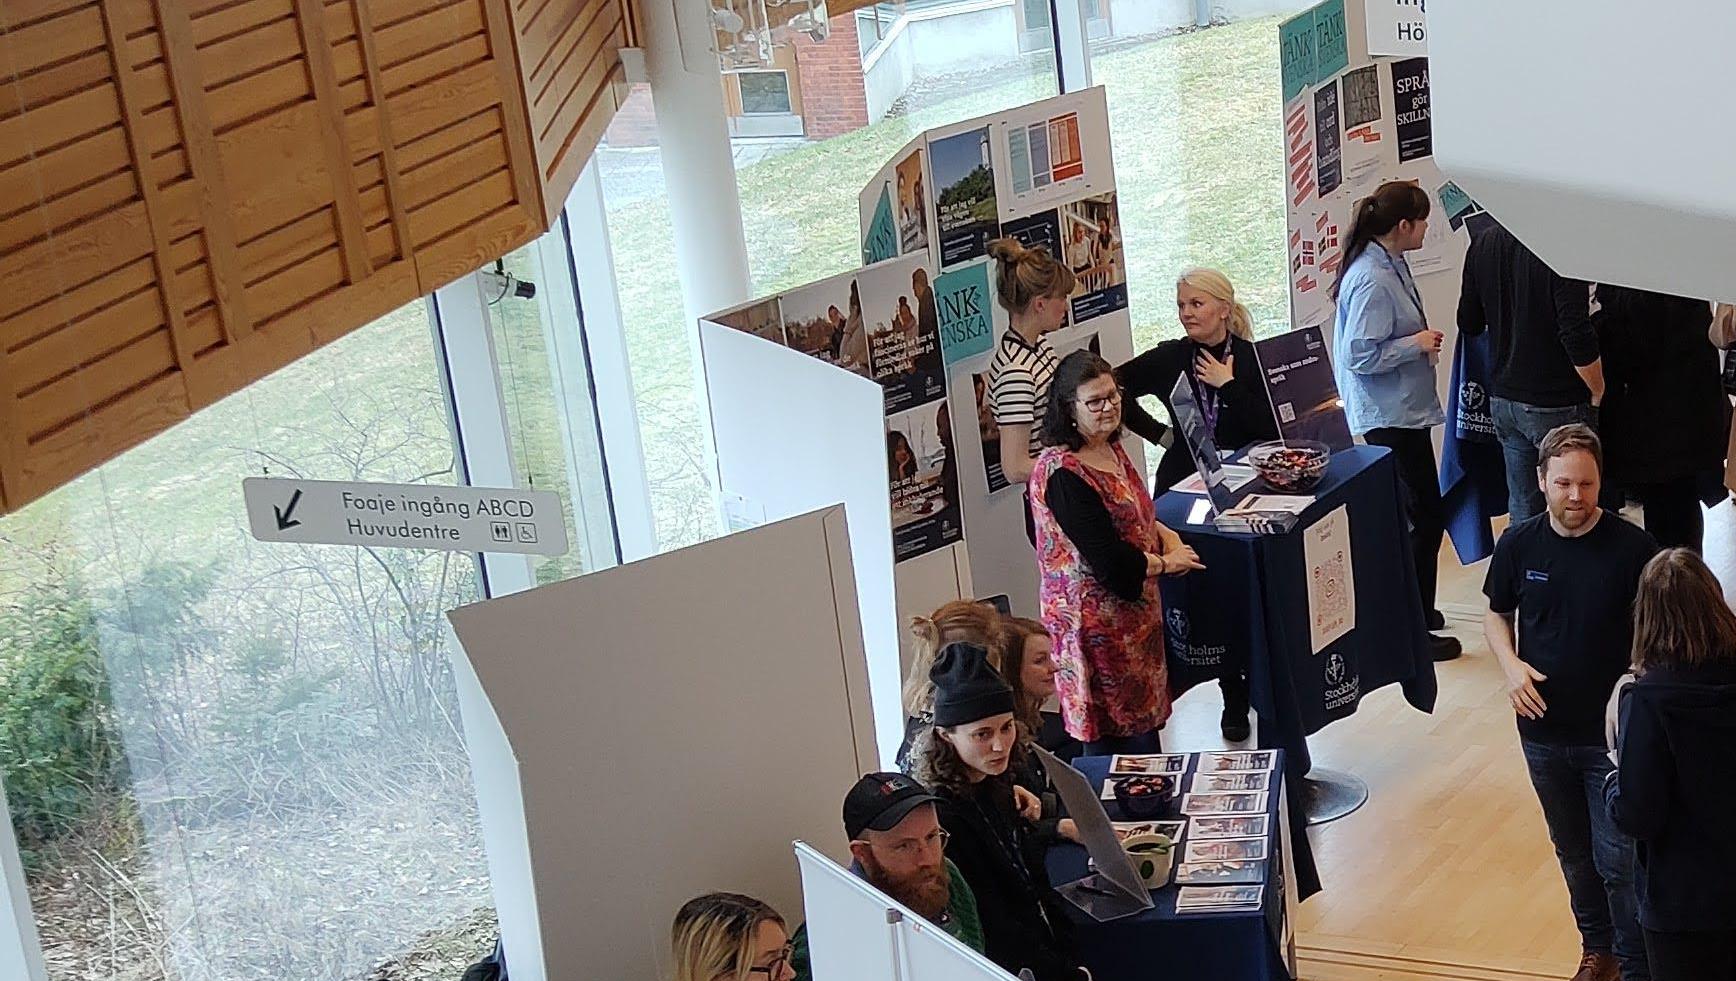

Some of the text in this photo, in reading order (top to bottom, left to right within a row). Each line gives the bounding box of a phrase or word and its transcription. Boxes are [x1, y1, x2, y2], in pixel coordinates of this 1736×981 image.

[342, 492, 534, 519] Foaje ingång ABCD
[347, 518, 460, 541] Huvudentre
